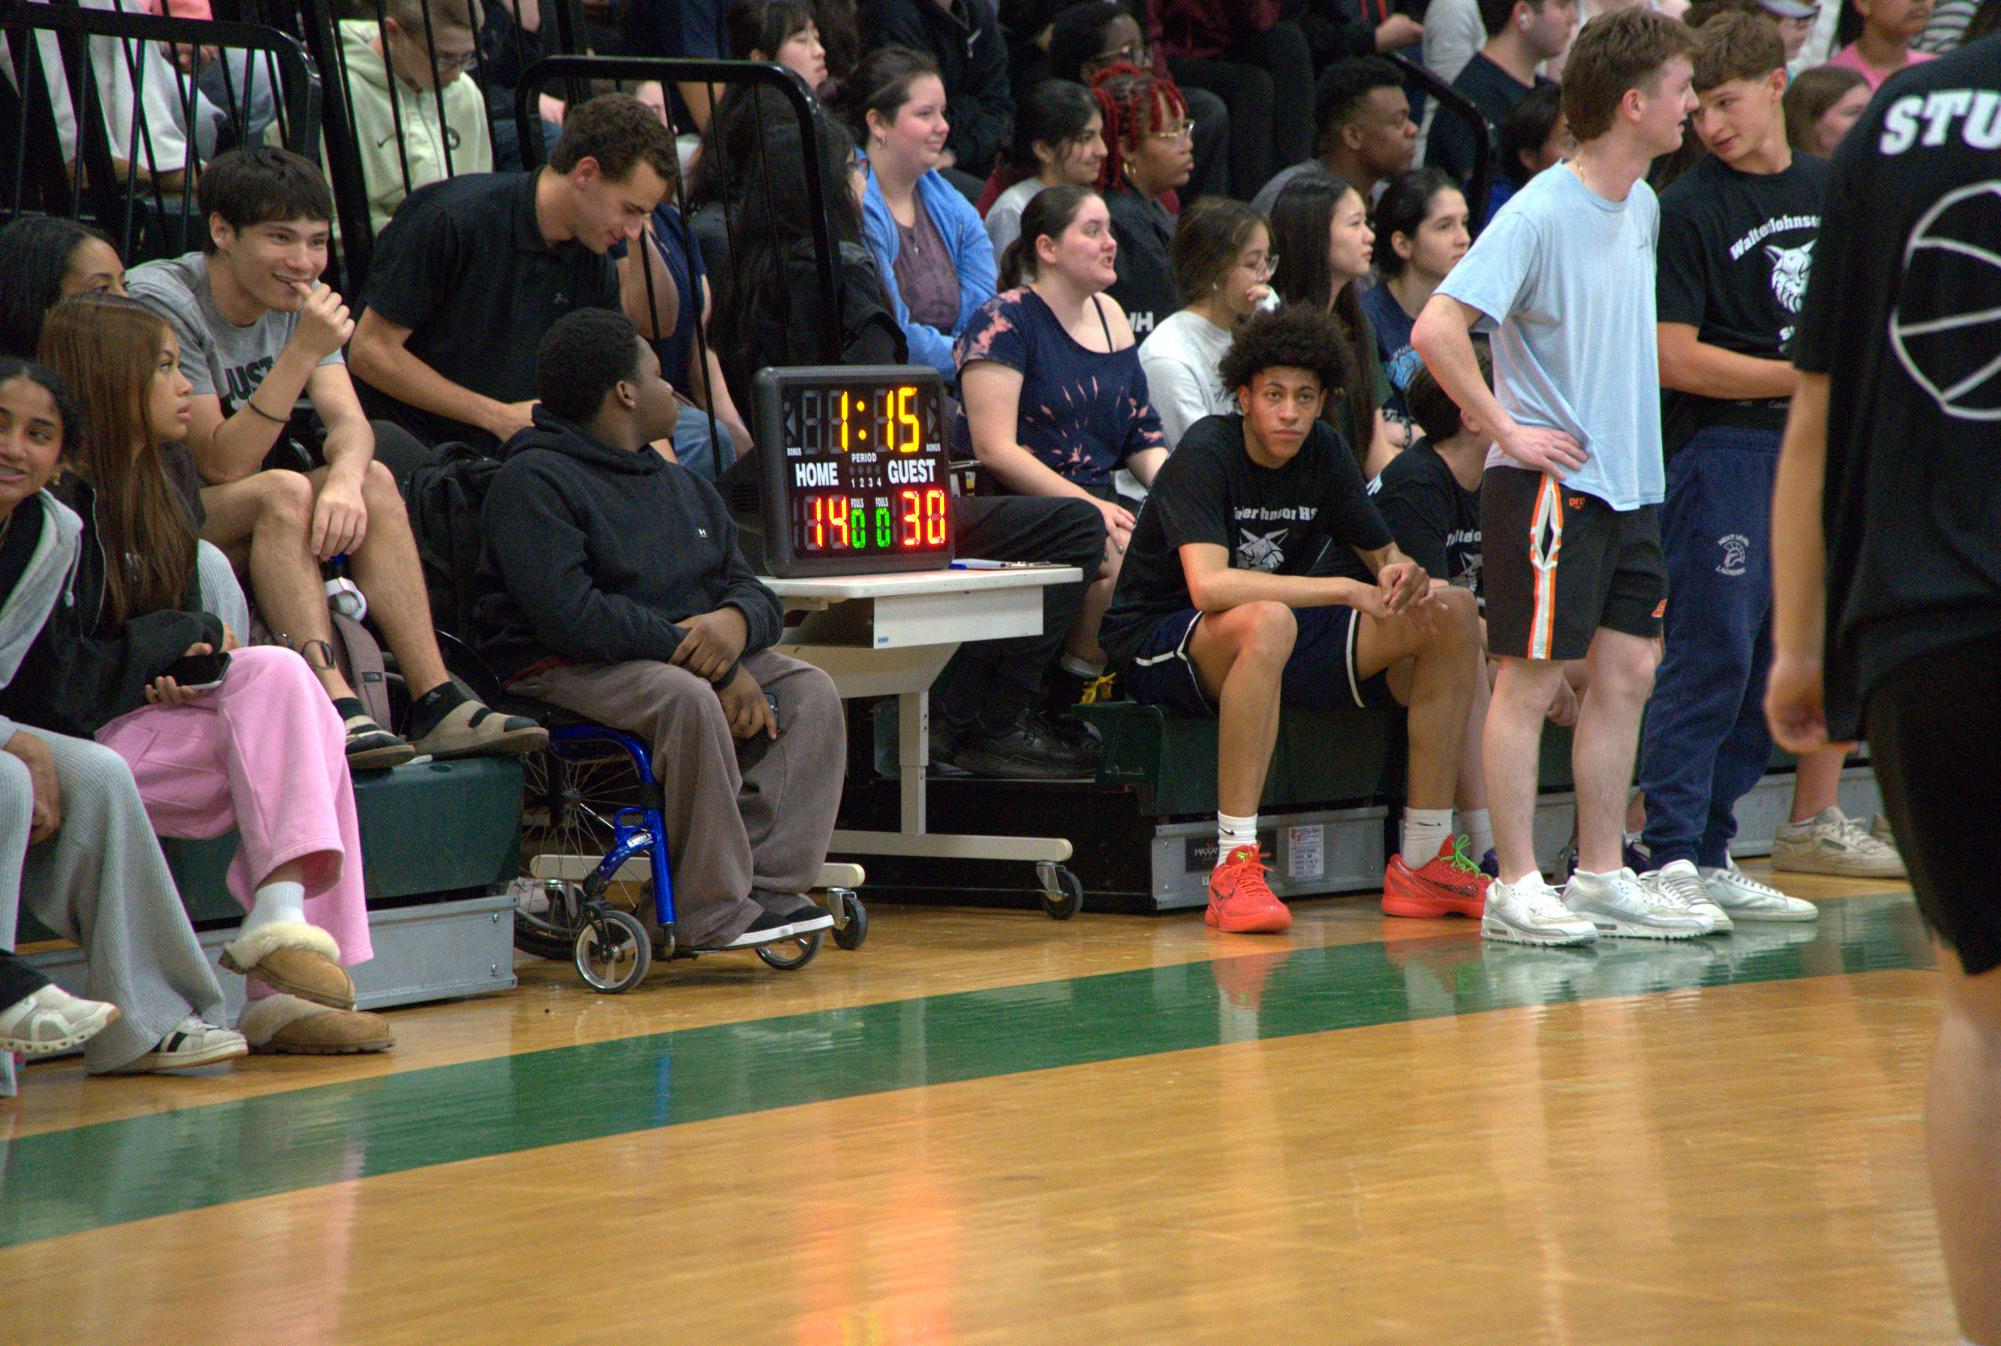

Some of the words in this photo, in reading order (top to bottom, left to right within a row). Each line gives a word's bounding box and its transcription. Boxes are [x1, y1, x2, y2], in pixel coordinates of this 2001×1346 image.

[841, 387, 920, 453] 1:15
[795, 462, 840, 487] HOME
[851, 452, 877, 464] PERIOD
[887, 459, 936, 484] GUEST
[851, 478, 856, 488] 1
[859, 477, 865, 488] 2
[868, 477, 873, 487] 3
[876, 476, 882, 487] 4
[816, 496, 848, 547] 14
[851, 508, 866, 549] 0
[875, 507, 891, 547] 0
[902, 490, 945, 546] 30
